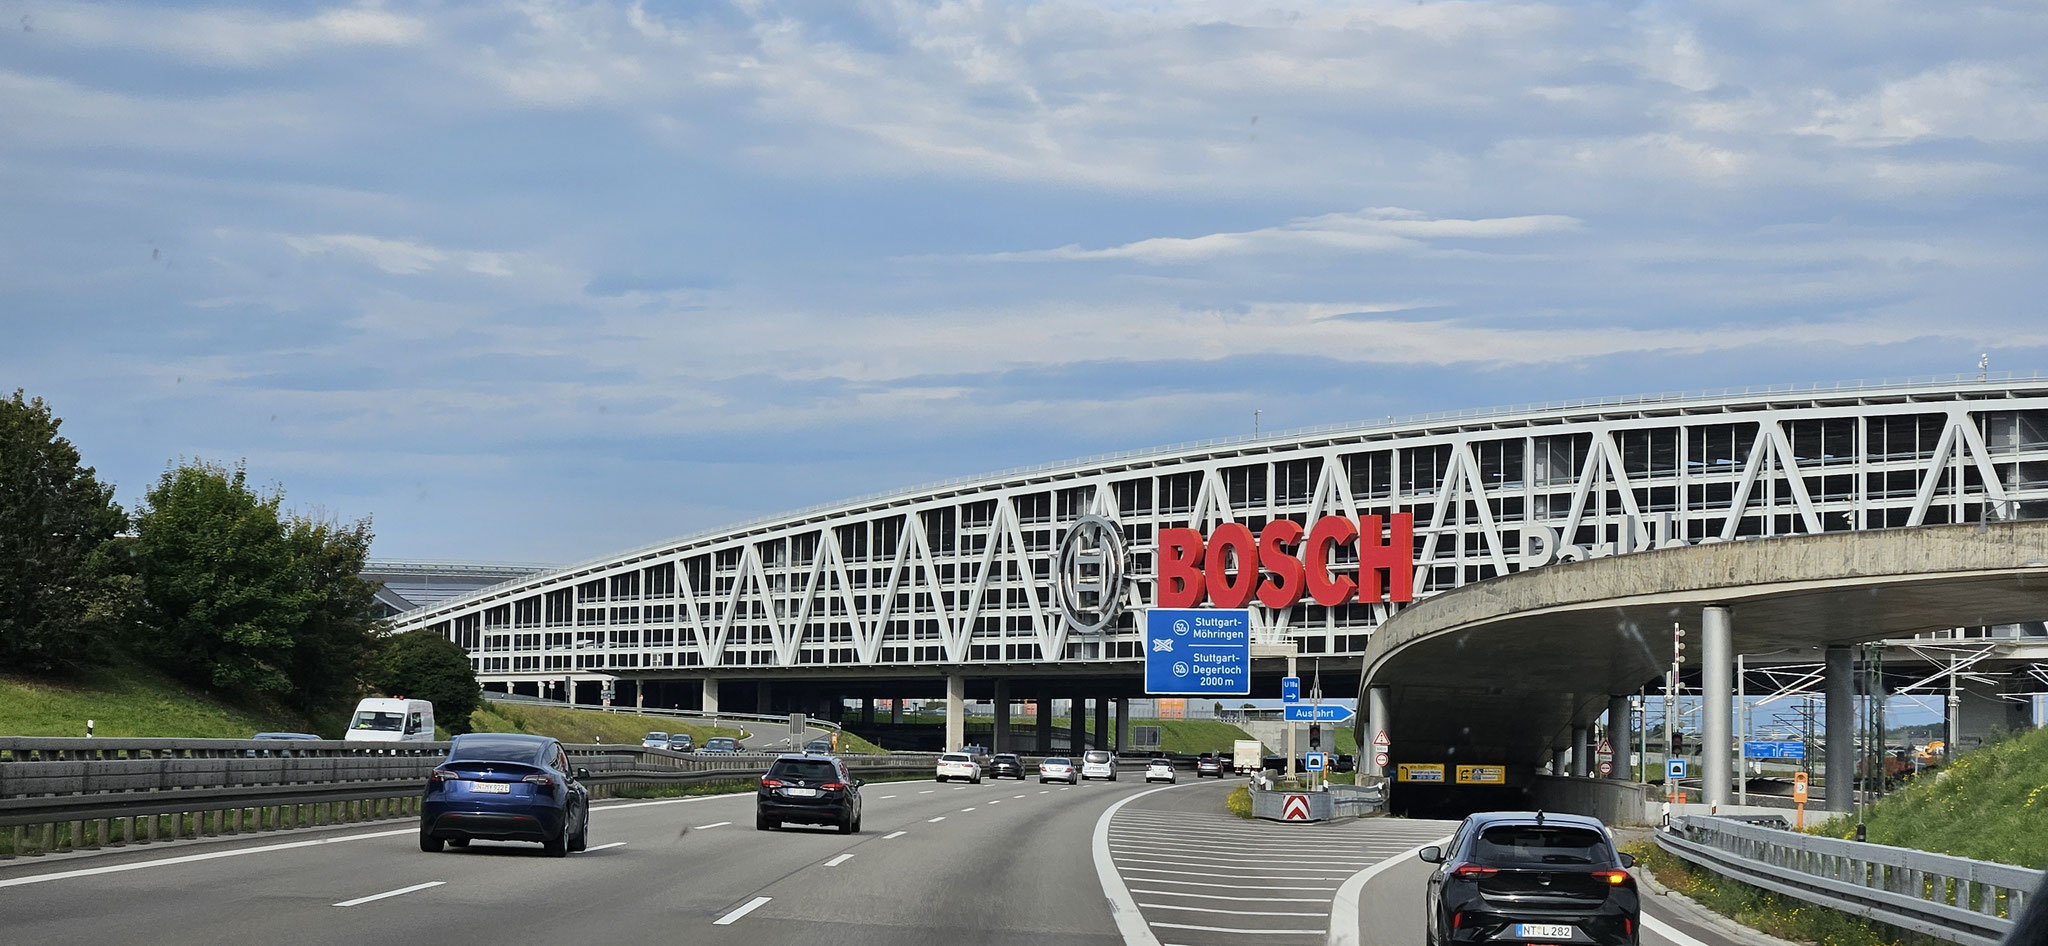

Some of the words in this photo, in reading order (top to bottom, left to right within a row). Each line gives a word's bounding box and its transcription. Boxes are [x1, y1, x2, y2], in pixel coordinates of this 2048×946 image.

[1158, 512, 1413, 609] BOSCH
[1195, 617, 1242, 629] Stuttgart-
[1193, 629, 1244, 640] Möhringen
[1193, 653, 1240, 664] Stuttgart-
[1193, 665, 1242, 676] Degerloch
[1200, 677, 1224, 686] 2000
[1523, 925, 1537, 935] NT
[1542, 926, 1549, 936] L
[1551, 926, 1570, 937] 282
